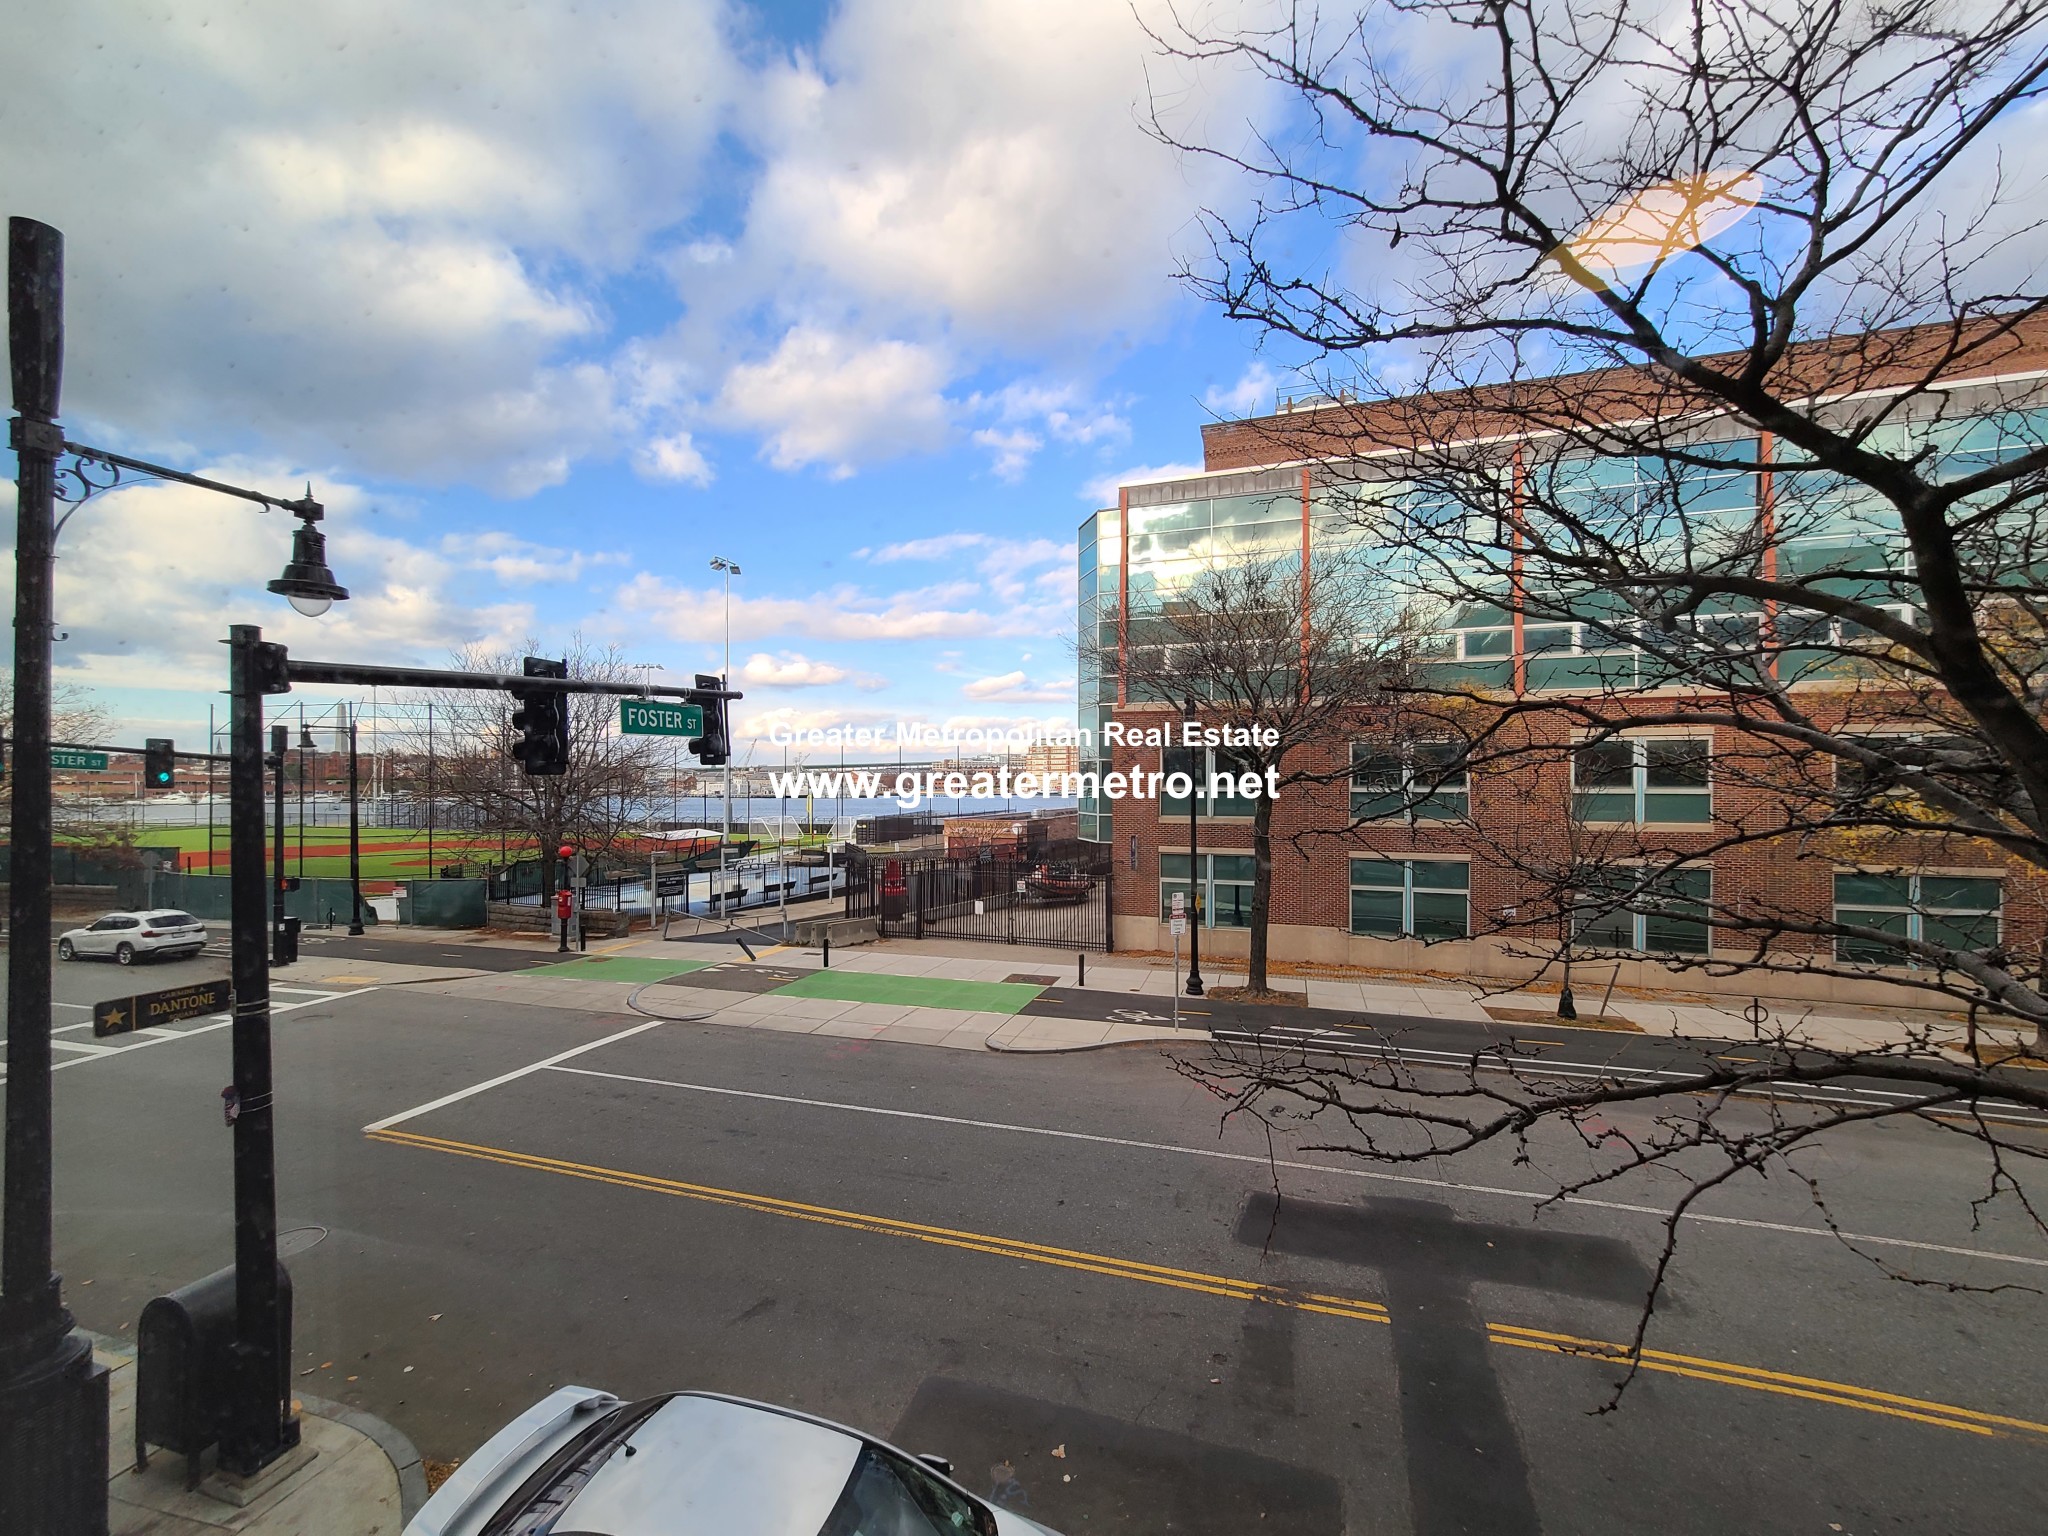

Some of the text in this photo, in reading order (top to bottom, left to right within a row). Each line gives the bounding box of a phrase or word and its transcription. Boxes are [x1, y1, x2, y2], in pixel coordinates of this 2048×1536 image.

[628, 708, 697, 730] FOSTER ST
[51, 755, 87, 766] STER
[150, 992, 216, 1015] DANTONE
[169, 1010, 199, 1020] SQUARE
